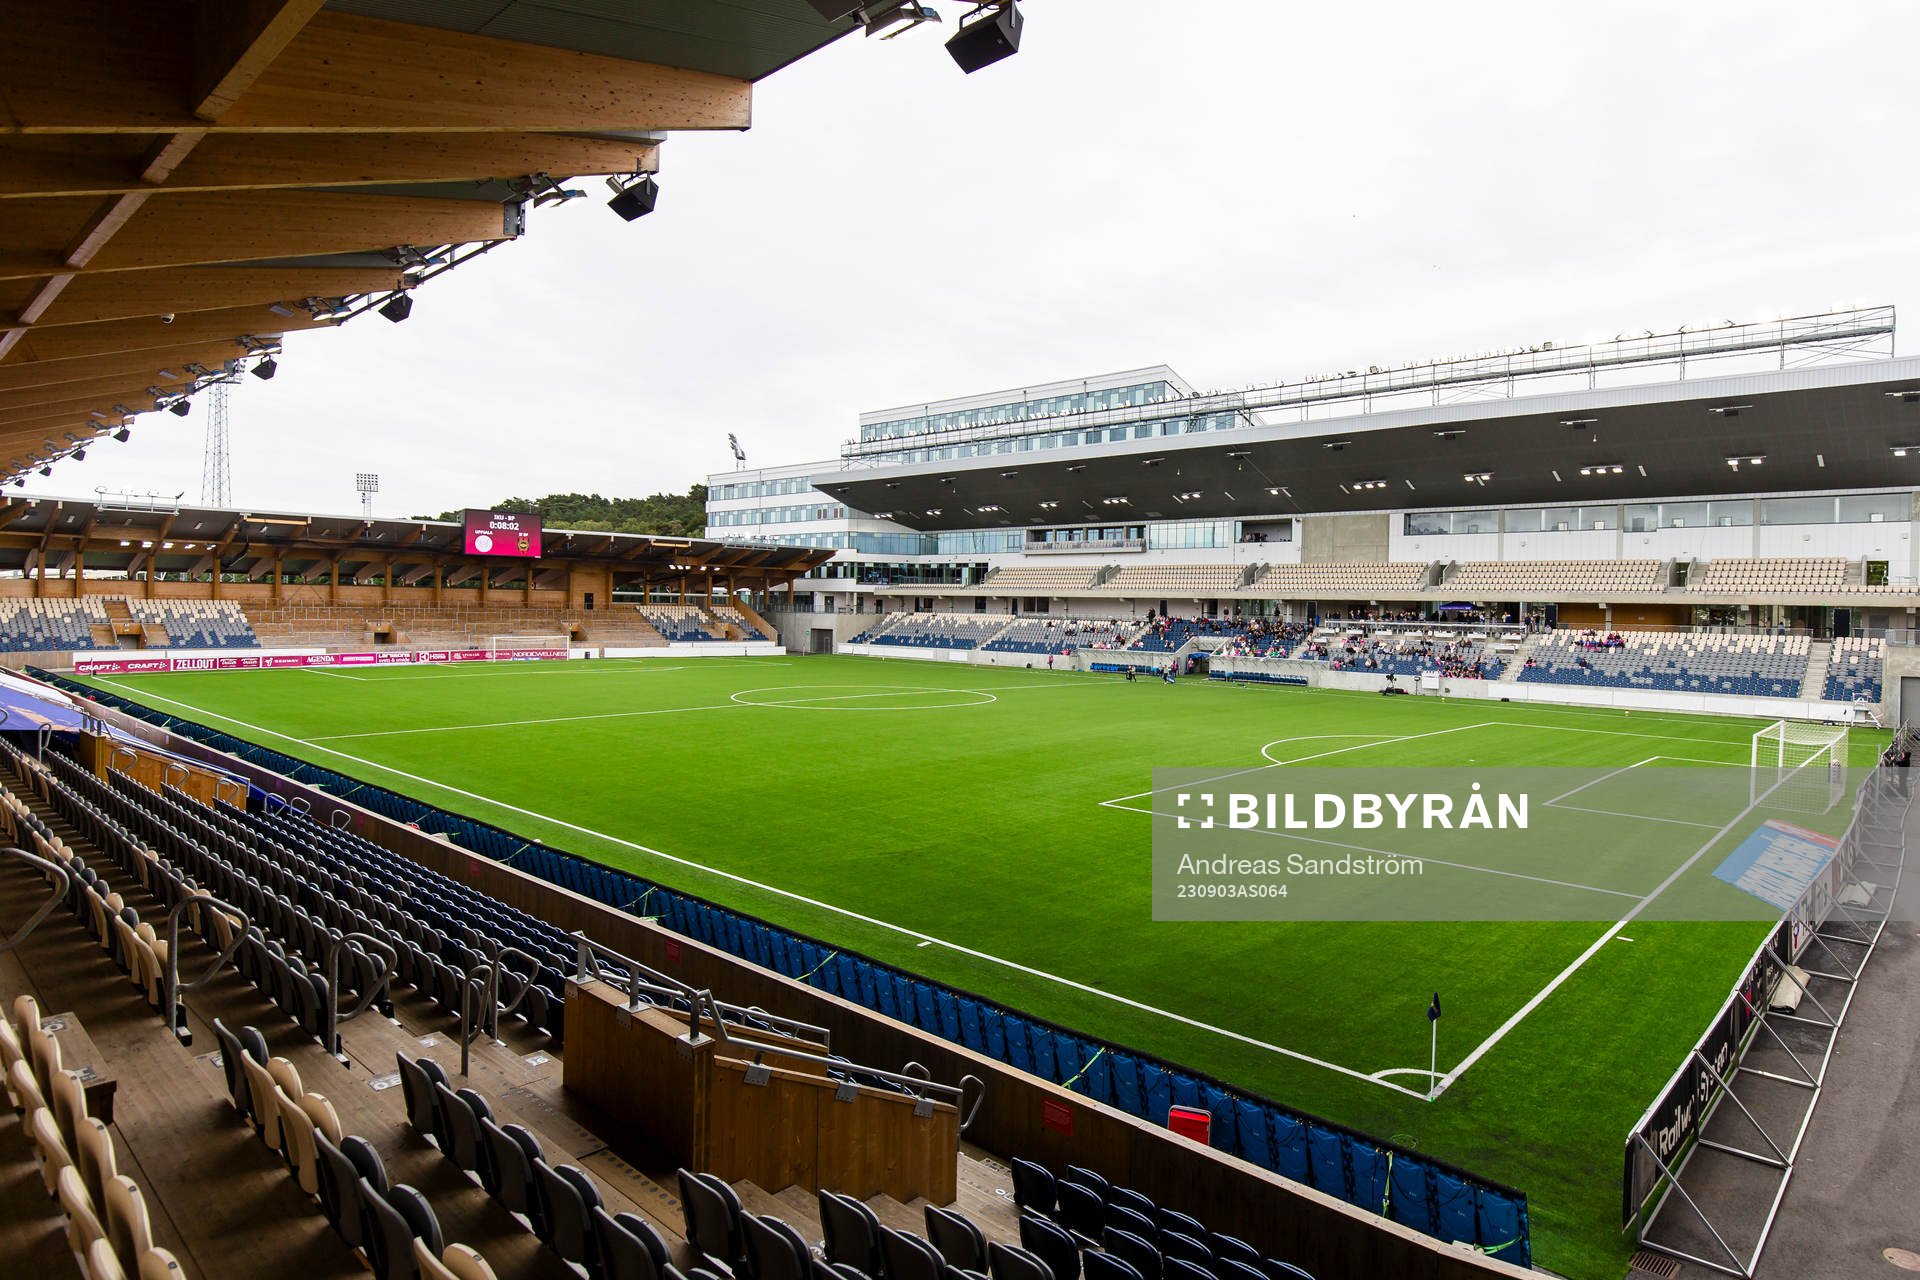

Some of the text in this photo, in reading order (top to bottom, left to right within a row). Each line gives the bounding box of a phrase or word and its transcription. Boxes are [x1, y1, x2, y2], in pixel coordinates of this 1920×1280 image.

[489, 521, 520, 531] 0:08:02
[306, 655, 335, 663] AGENDA
[78, 663, 112, 672] CRAFT
[127, 662, 158, 670] CRAFT
[176, 659, 215, 670] ZELLOUT
